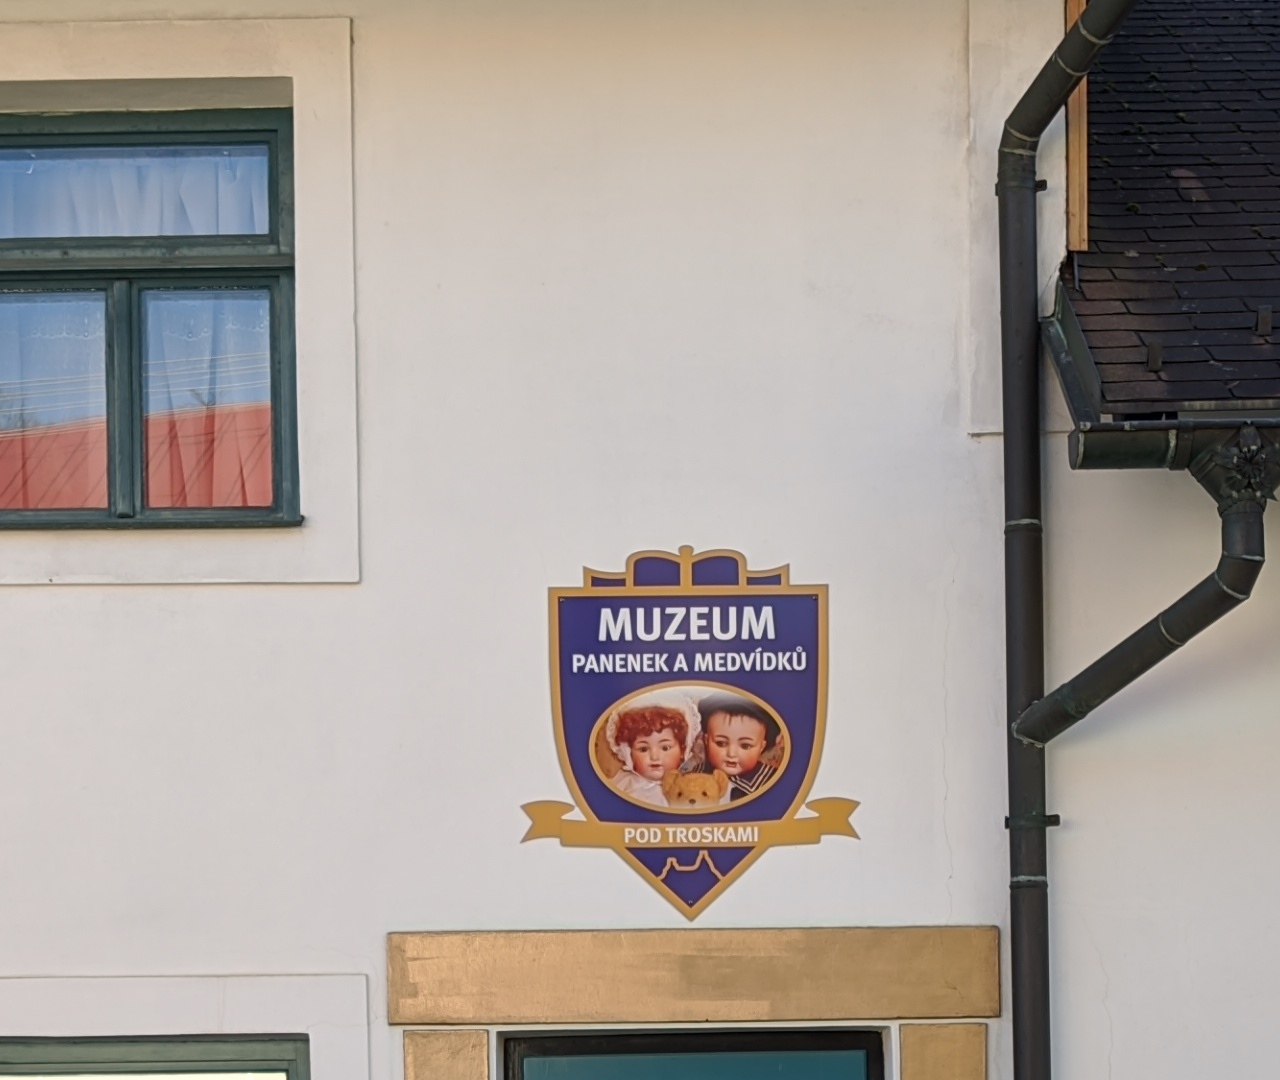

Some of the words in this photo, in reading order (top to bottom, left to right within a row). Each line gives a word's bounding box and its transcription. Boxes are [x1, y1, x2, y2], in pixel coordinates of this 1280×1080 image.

[598, 606, 776, 642] MUZEUM
[572, 652, 669, 673] PANENEK
[673, 652, 689, 672] A
[694, 646, 807, 672] MEDVÍDKŮ
[624, 827, 661, 844] POD
[666, 826, 759, 843] TROSKAMI
